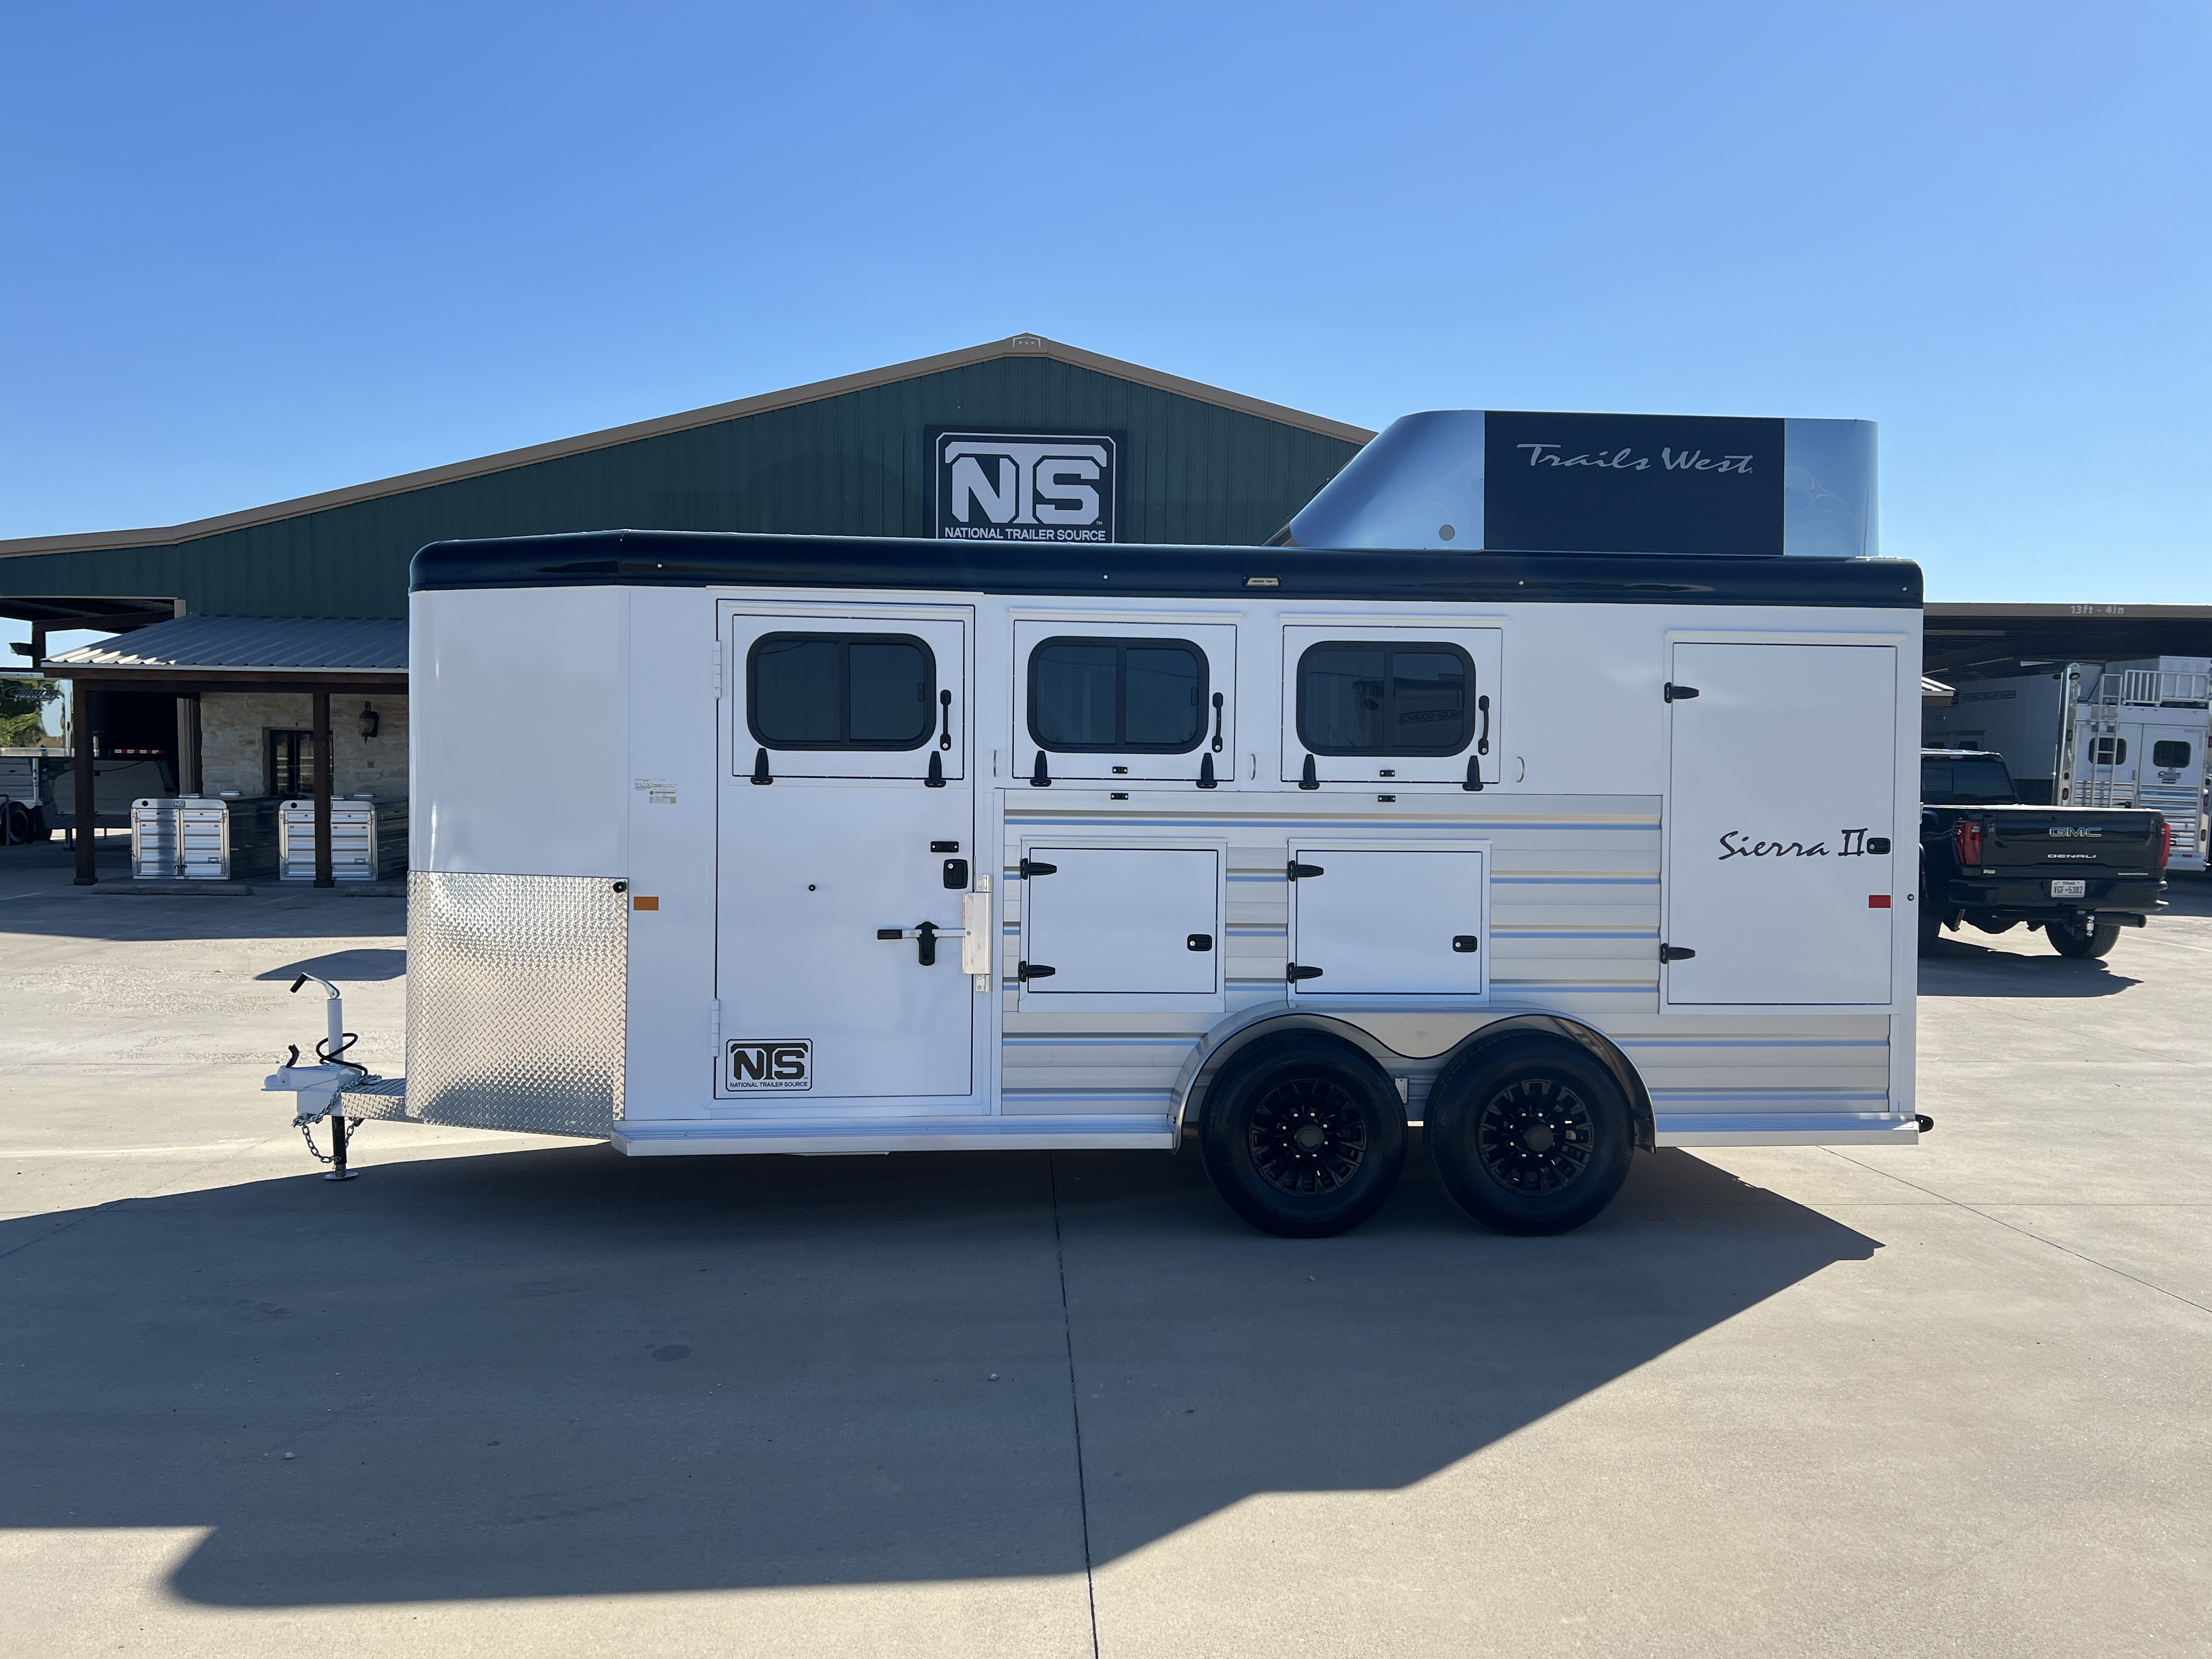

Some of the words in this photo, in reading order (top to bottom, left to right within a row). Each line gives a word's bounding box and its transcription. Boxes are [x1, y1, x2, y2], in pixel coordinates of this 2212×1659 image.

[1516, 443, 1651, 471] Trails
[1661, 447, 1753, 474] West
[945, 441, 1107, 525] NTS
[944, 527, 1004, 539] NATIONAL
[1005, 528, 1054, 540] TRAILER
[1057, 529, 1106, 541] SOURCE
[2071, 605, 2094, 614] 13ft
[2106, 605, 2125, 614] 4in
[1718, 830, 1831, 860] Sierra
[1837, 827, 1869, 857] II
[2049, 827, 2102, 837] GMC
[730, 1042, 809, 1080] NTS
